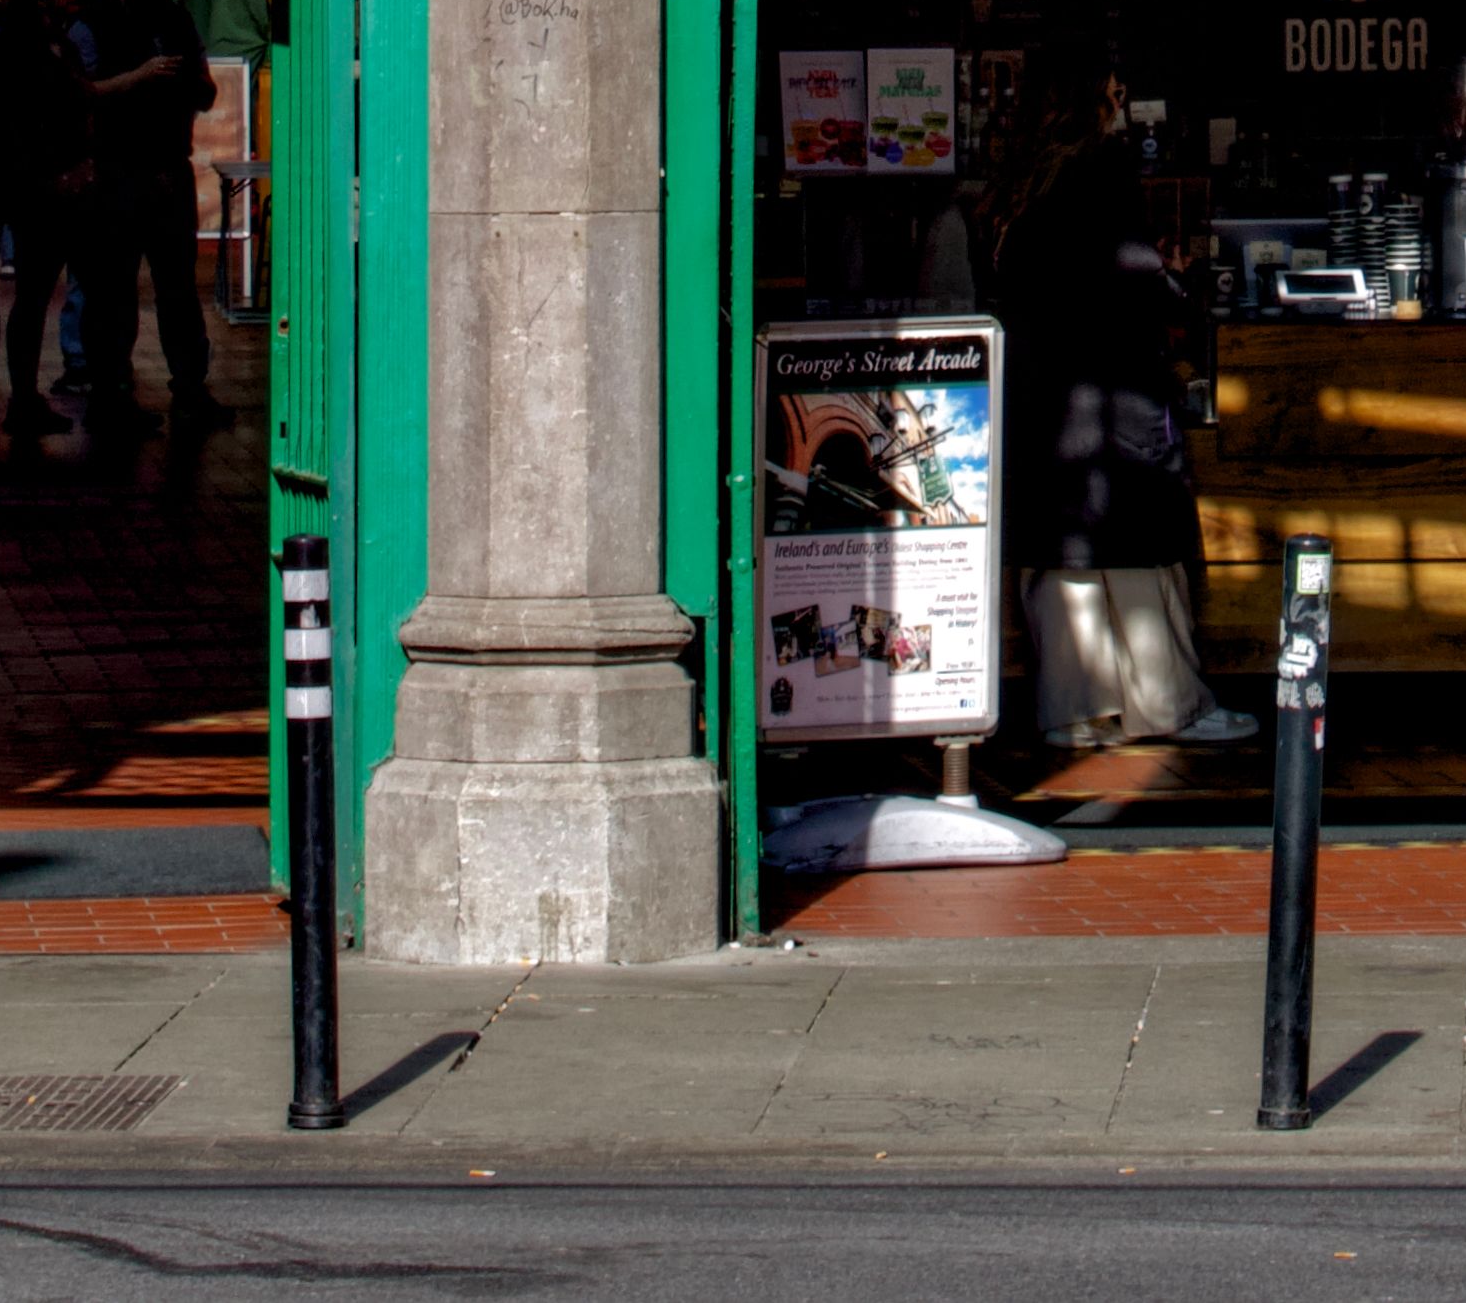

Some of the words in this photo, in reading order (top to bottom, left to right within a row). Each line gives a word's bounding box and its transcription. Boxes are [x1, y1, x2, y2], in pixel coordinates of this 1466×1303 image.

[1285, 17, 1428, 72] BODEGA
[776, 351, 856, 381] George's
[860, 349, 915, 371] Street
[917, 347, 981, 371] Arcade
[775, 541, 819, 558] Ireland's
[822, 540, 842, 555] and
[846, 538, 889, 557] Europe's
